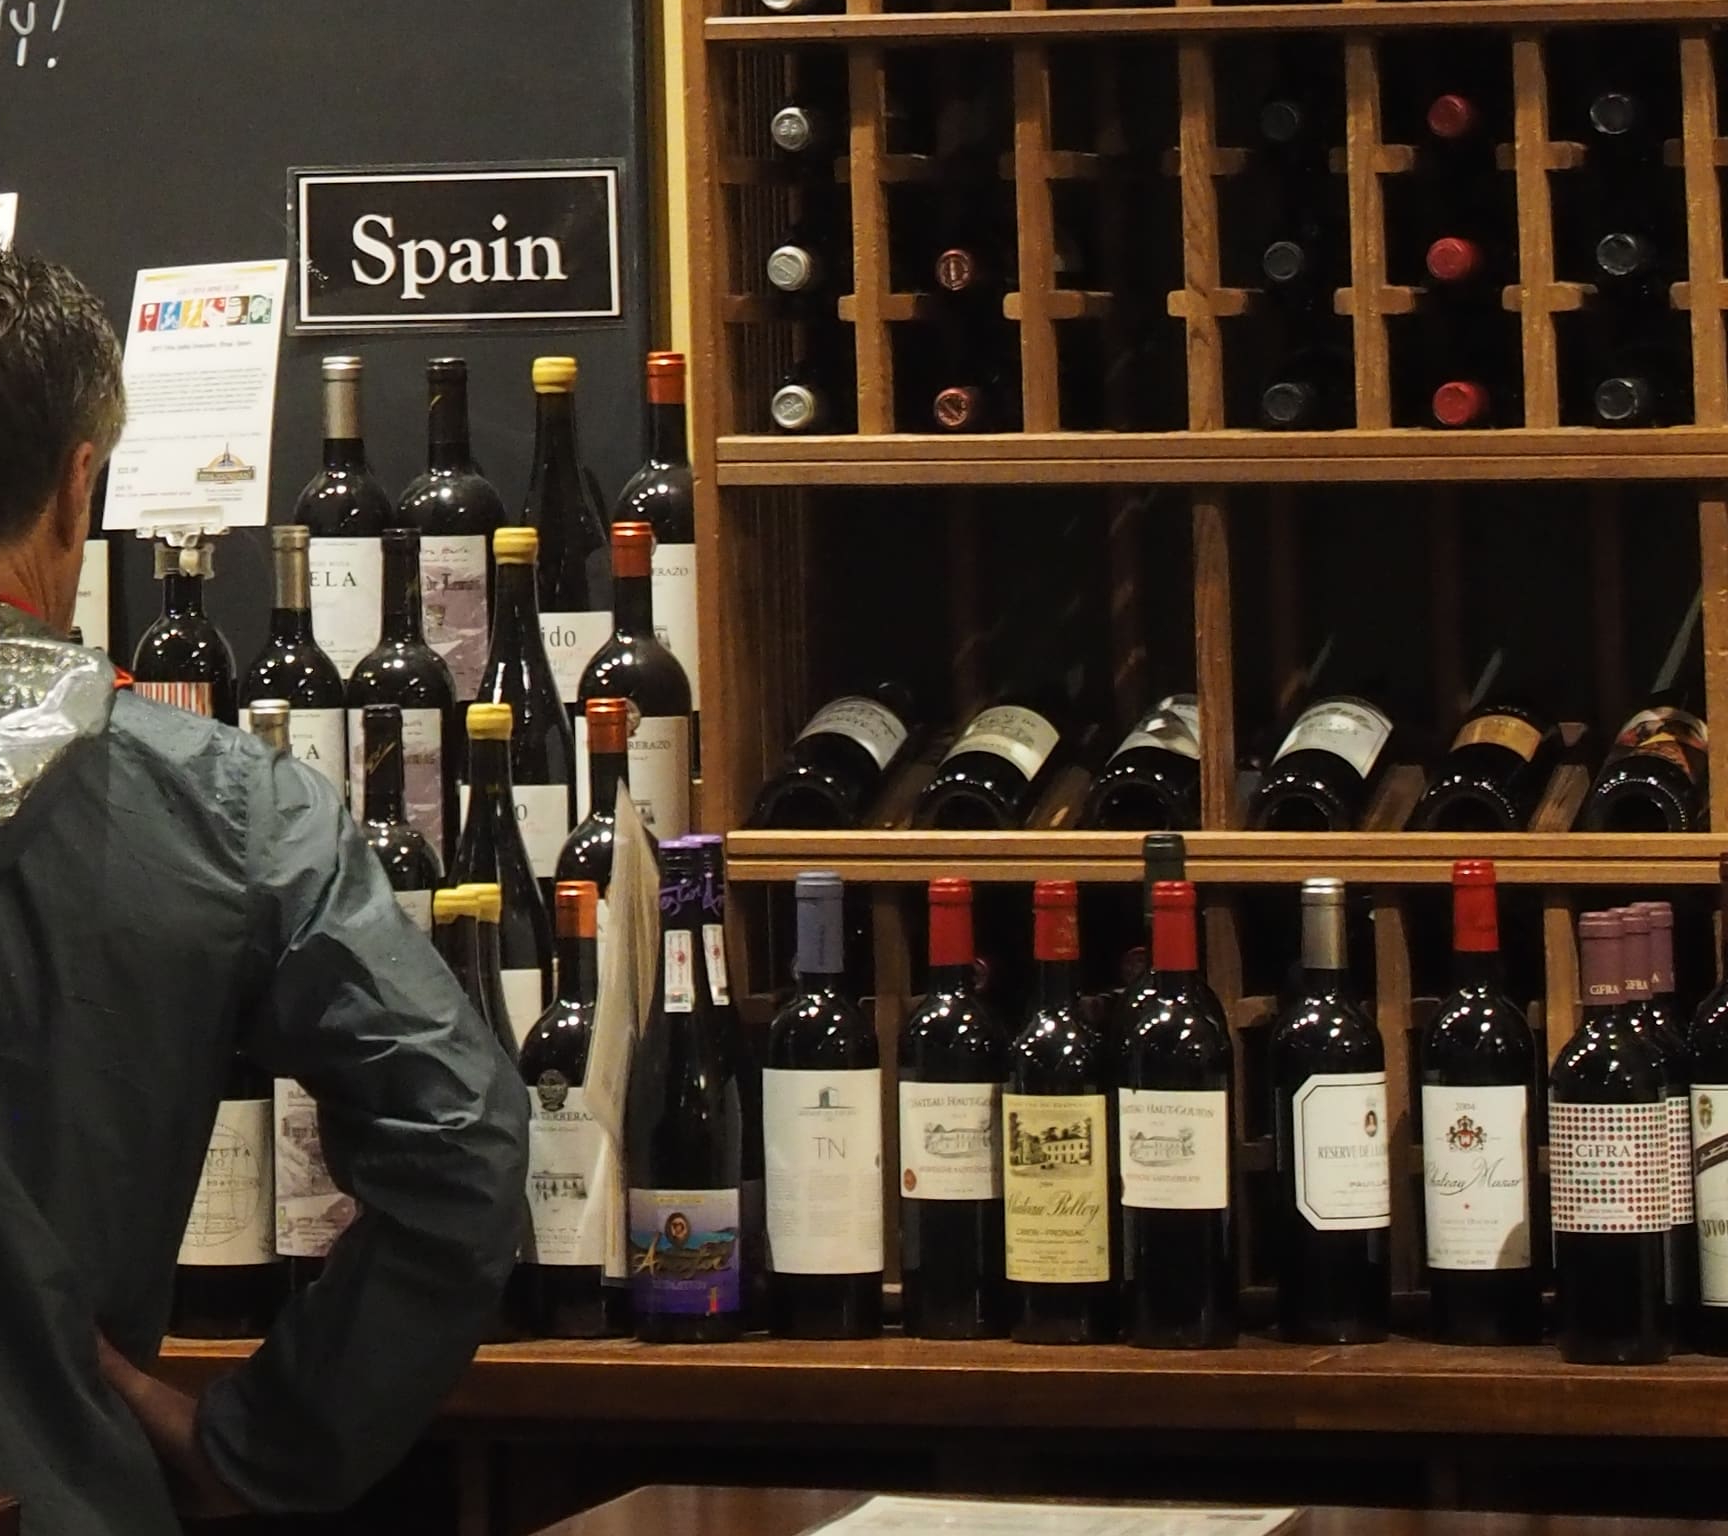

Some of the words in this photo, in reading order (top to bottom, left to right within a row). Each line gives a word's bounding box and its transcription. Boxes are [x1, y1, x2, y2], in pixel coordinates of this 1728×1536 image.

[351, 214, 569, 300] Spain
[812, 1137, 846, 1160] TN
[1575, 1142, 1633, 1159] CiFRA
